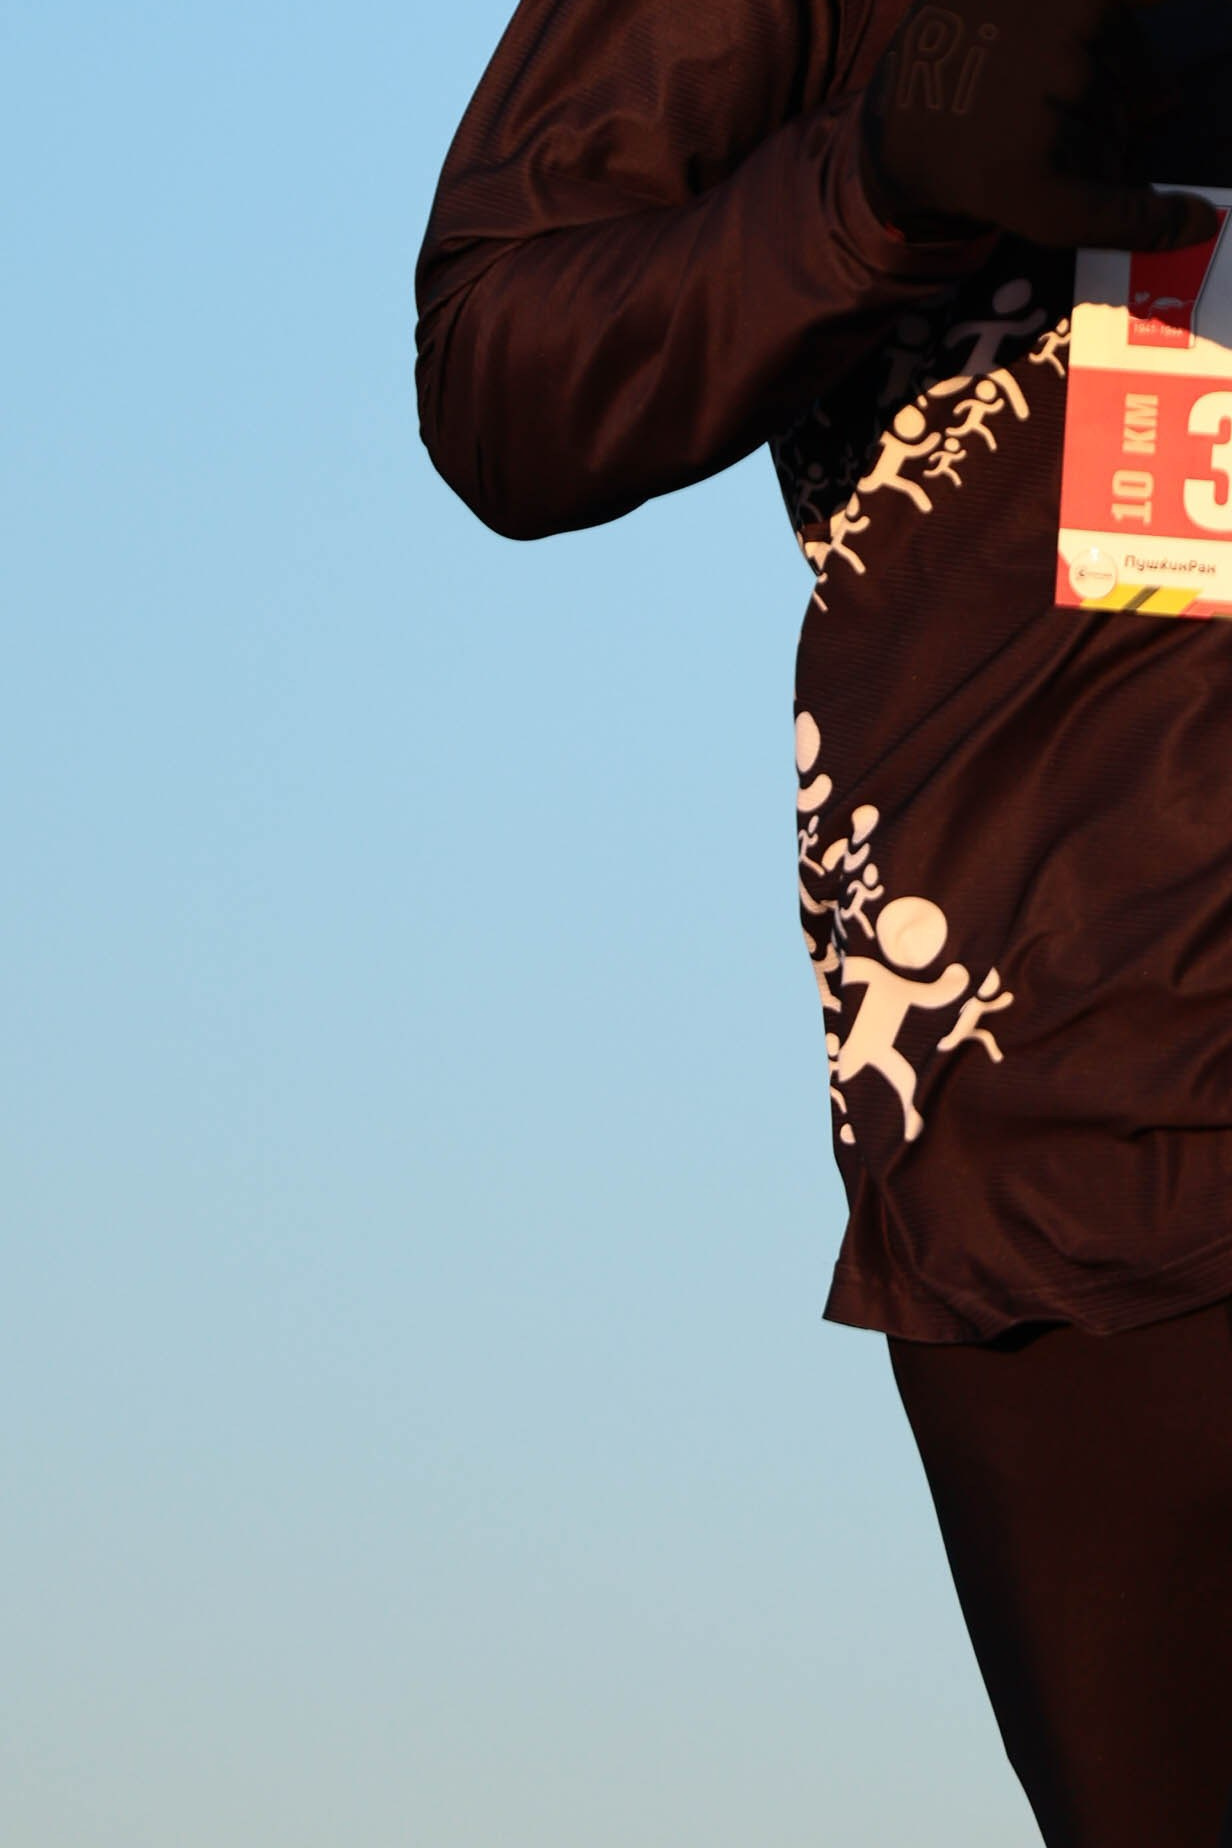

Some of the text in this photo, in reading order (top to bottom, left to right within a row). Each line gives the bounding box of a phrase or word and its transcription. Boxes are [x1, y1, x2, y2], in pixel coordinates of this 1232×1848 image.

[872, 5, 978, 116] Ri
[1111, 392, 1159, 526] 10 КМ
[1123, 554, 1217, 575] ПушкинРан
